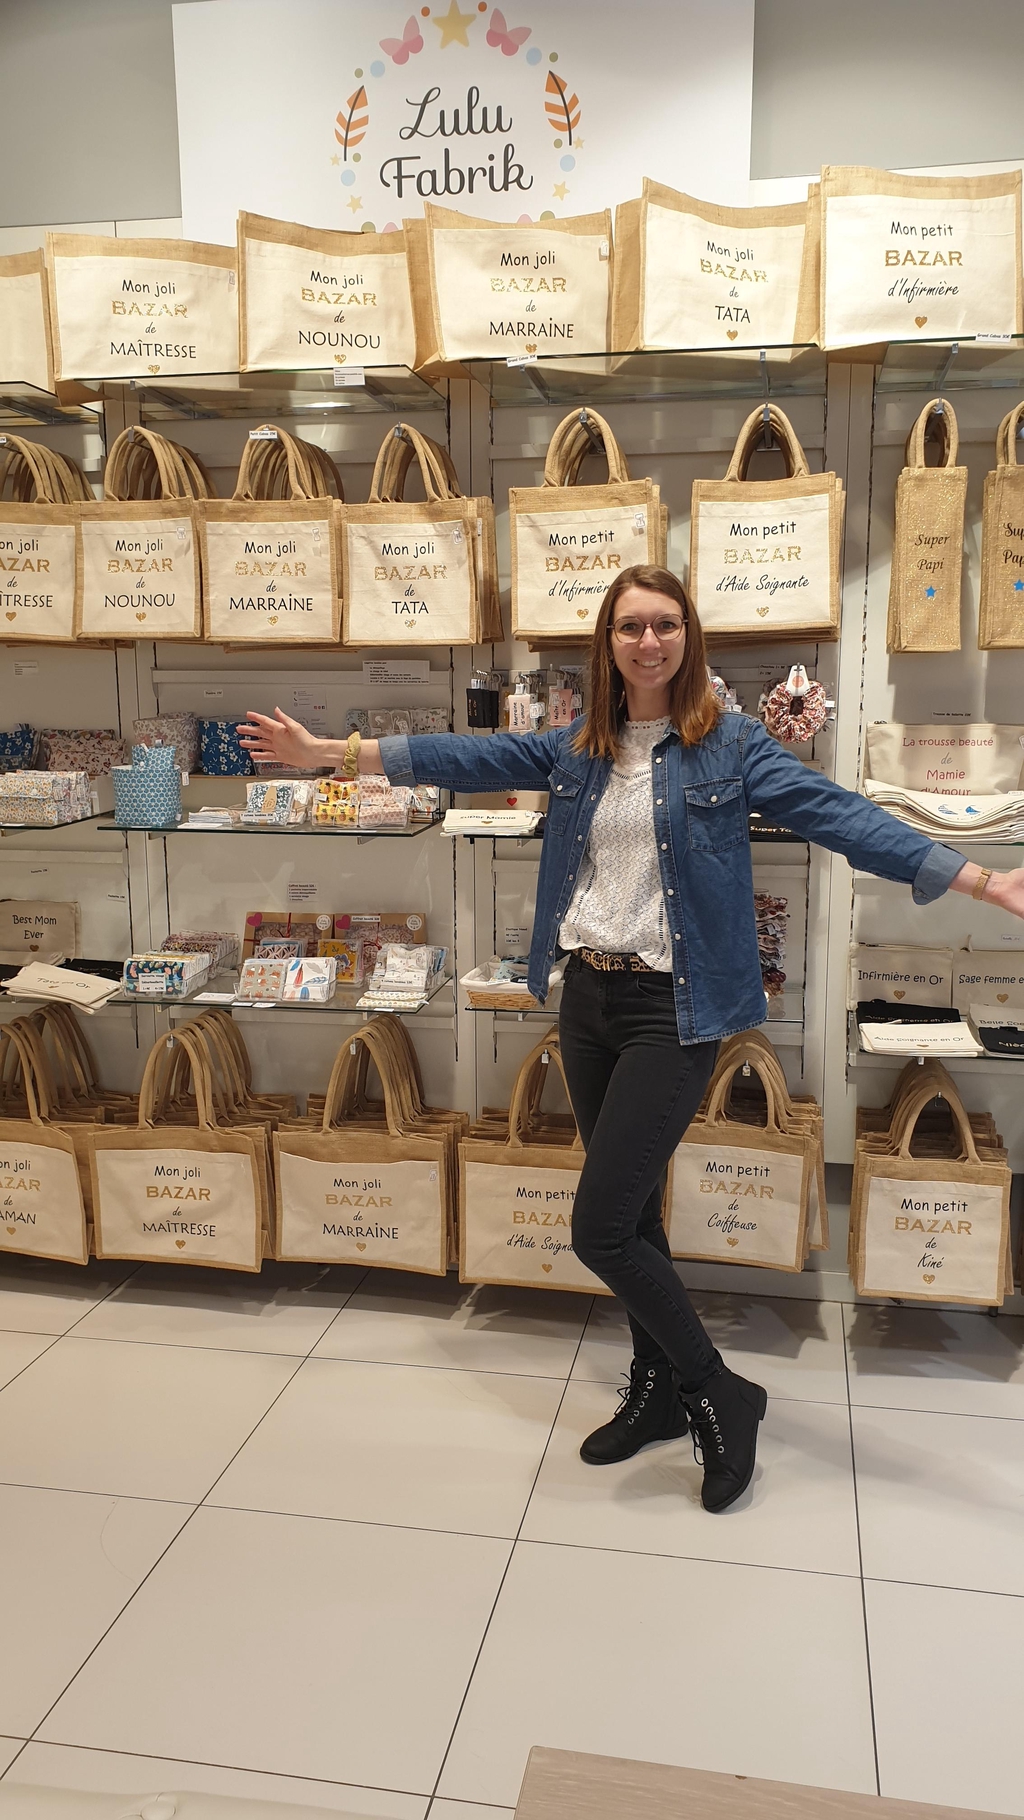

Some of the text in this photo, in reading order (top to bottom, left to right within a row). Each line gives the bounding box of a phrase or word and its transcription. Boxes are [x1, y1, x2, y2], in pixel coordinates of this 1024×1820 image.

[399, 86, 512, 140] Lulu
[380, 143, 533, 198] Fabrik
[891, 221, 953, 240] Mon petit
[707, 240, 754, 262] Mon joli
[885, 250, 963, 267] BAZAR
[500, 251, 556, 269] Mon joli
[700, 258, 769, 283] BAZAR
[310, 270, 364, 289] Mon joli
[489, 277, 568, 293] BAZAR
[121, 279, 176, 297] Mon joli
[729, 286, 740, 298] de
[888, 277, 959, 303] d'Infirmière
[301, 287, 378, 307] BAZAR
[112, 300, 189, 318] BAZAR
[525, 299, 537, 313] de
[333, 310, 346, 324] de
[715, 305, 751, 324] TATA
[145, 321, 157, 334] de
[298, 330, 381, 349] NOUNOU
[110, 339, 197, 359] MAÎTRESSE
[730, 521, 797, 540] Mon petit
[0, 539, 39, 554] on joli
[115, 539, 163, 555] Mon joli
[549, 530, 614, 548] Mon petit
[914, 534, 951, 549] Super
[244, 540, 296, 557] Mon joli
[382, 542, 435, 559] Mon joli
[723, 546, 802, 565] BAZAR
[107, 557, 174, 573] BAZAR
[234, 561, 307, 577] BAZAR
[545, 554, 622, 572] BAZAR
[917, 558, 945, 574] Papi
[374, 564, 448, 581] BAZAR
[7, 576, 18, 588] de
[136, 576, 146, 588] de
[266, 580, 277, 593] de
[716, 574, 810, 596] d'Aide Soignante
[405, 584, 415, 597] de
[549, 580, 610, 602] d'Infirmièr
[104, 593, 175, 608] NOUNOU
[391, 601, 429, 614] TATA
[902, 737, 994, 747] La trousse beauté
[941, 752, 953, 765] de
[926, 769, 966, 780] Mamie
[12, 914, 57, 925] Best Mom
[23, 930, 45, 940] Ever
[858, 970, 944, 986] Infirmière en Or
[959, 974, 1024, 984] Sage femme e
[13, 1159, 31, 1172] joli
[154, 1165, 201, 1181] Mon joli
[705, 1161, 770, 1178] Mon petit
[333, 1177, 382, 1191] Mon joli
[699, 1178, 775, 1199] BAZAR
[4, 1195, 13, 1205] de
[146, 1185, 211, 1202] BAZAR
[325, 1194, 393, 1208] BAZAR
[516, 1187, 576, 1202] Mon petit
[172, 1206, 182, 1217] de
[728, 1199, 739, 1211] de
[900, 1198, 968, 1215] Mon petit
[353, 1211, 363, 1222] de
[707, 1215, 758, 1233] Coiffeuse
[142, 1219, 216, 1238] MAÎTRESSE
[894, 1217, 972, 1235] BAZAR
[507, 1233, 574, 1255] d'Aide Soigna
[925, 1237, 937, 1249] de
[917, 1252, 944, 1269] Kiné
